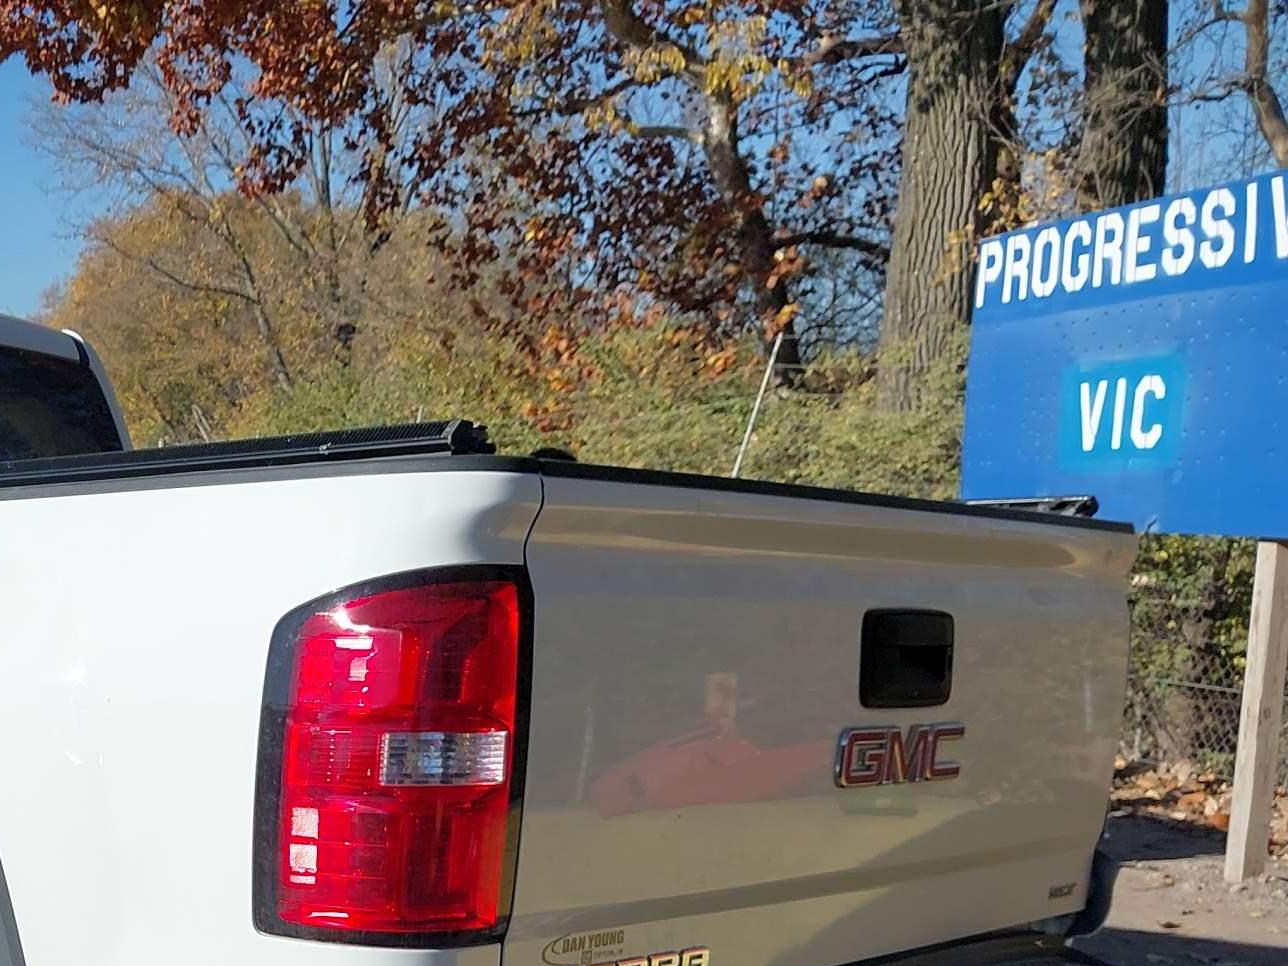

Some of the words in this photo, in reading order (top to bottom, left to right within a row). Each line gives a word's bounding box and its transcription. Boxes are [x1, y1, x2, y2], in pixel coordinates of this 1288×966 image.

[1079, 374, 1167, 452] VIC
[834, 721, 966, 788] GMC
[562, 935, 586, 954] DAN
[587, 929, 625, 948] YOUNG
